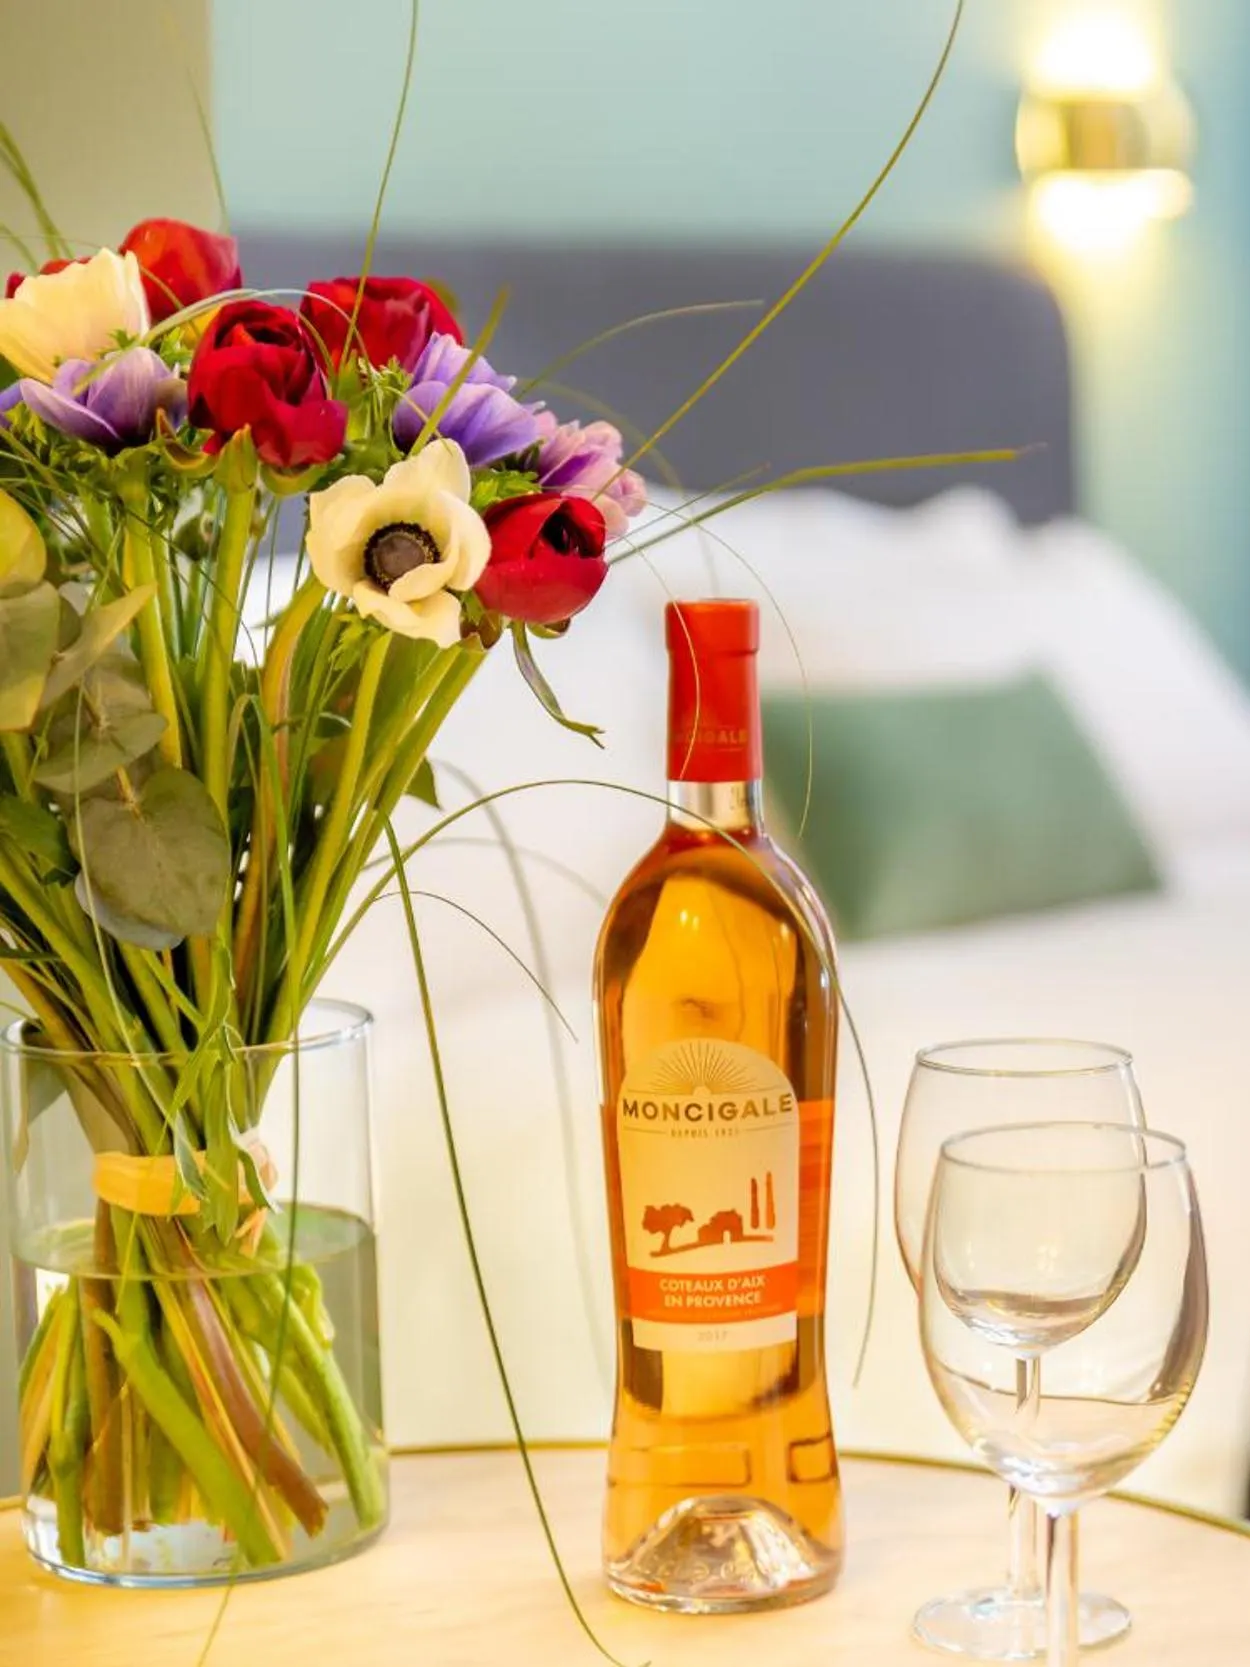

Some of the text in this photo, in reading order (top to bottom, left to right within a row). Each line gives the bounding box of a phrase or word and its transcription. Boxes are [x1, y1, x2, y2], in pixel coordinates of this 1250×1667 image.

[622, 1094, 792, 1122] MONCIGALE
[659, 1275, 766, 1292] COTEAUX D'AIX
[664, 1291, 761, 1308] EN PROVENCE
